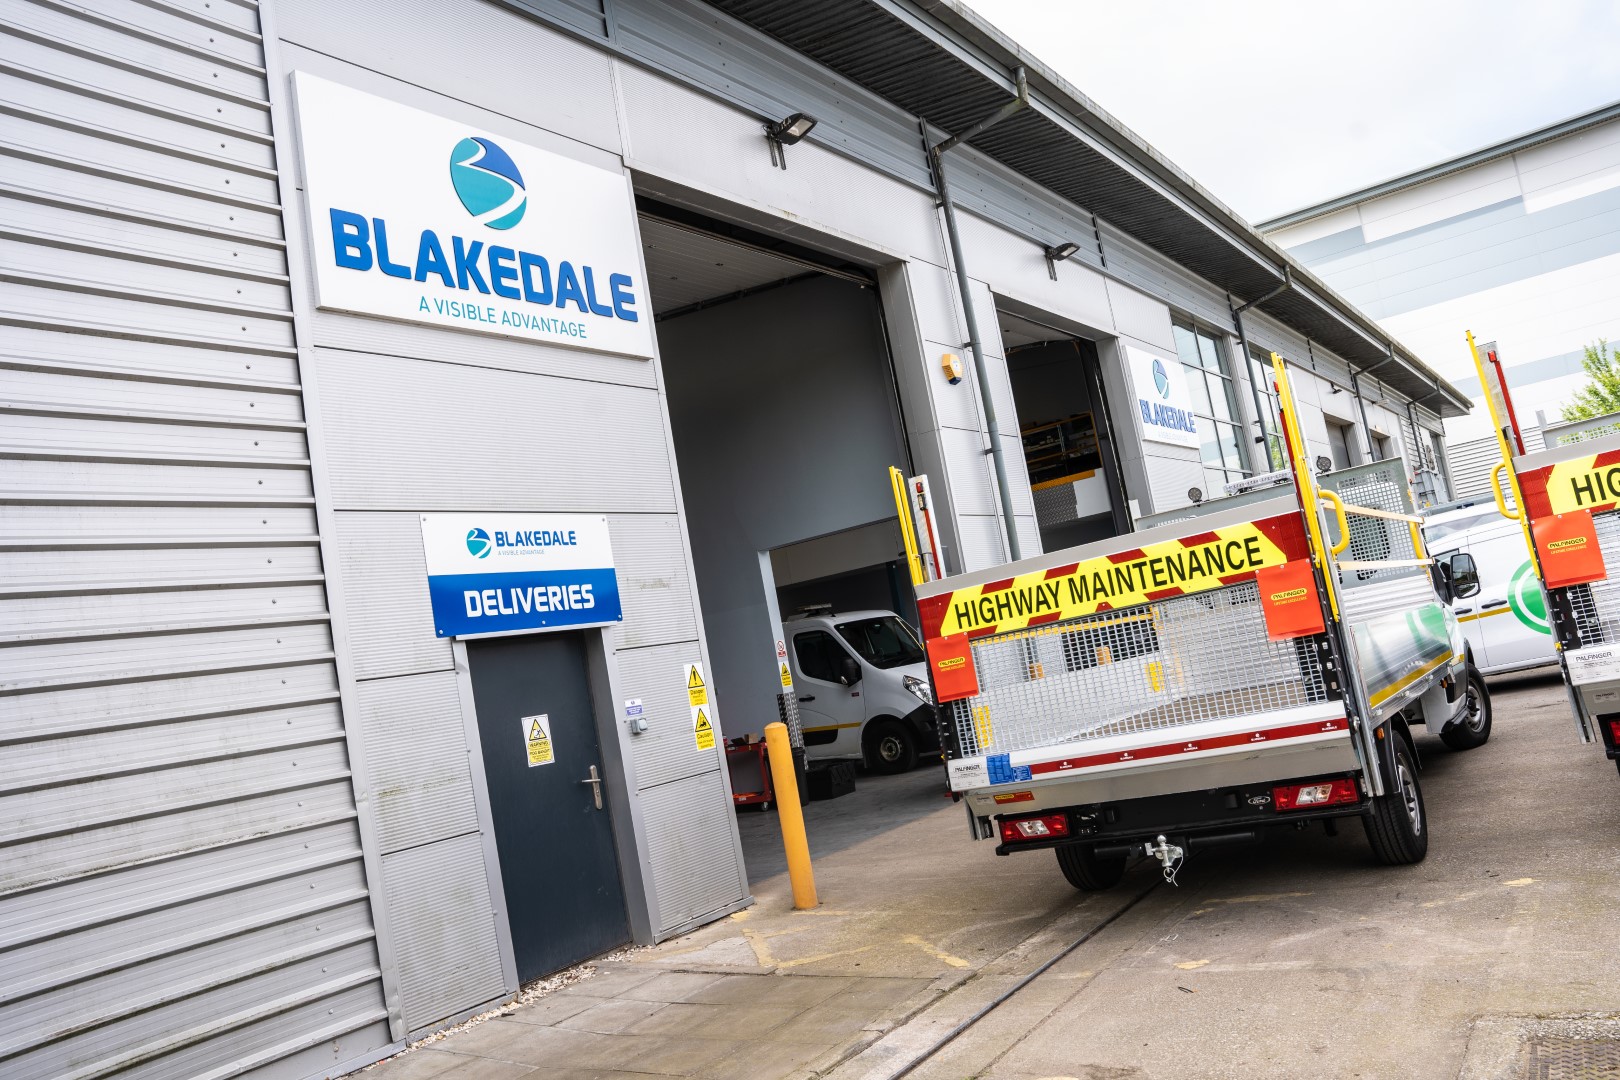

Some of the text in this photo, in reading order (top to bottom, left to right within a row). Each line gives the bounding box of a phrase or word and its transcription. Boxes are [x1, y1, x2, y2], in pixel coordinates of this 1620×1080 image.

[329, 207, 639, 322] BLAKEDALE
[419, 296, 588, 339] A VISIBLE ADVANTAGE
[1139, 399, 1196, 433] BLAKEDALE
[494, 530, 577, 547] BLAKEDALE
[1549, 537, 1585, 548] PALFINGER
[954, 536, 1264, 629] HIGHWAY MAINTENANCE
[1272, 588, 1306, 600] PALFINGER
[463, 583, 595, 618] DELIVERIES
[1575, 651, 1613, 662] PALFINGER
